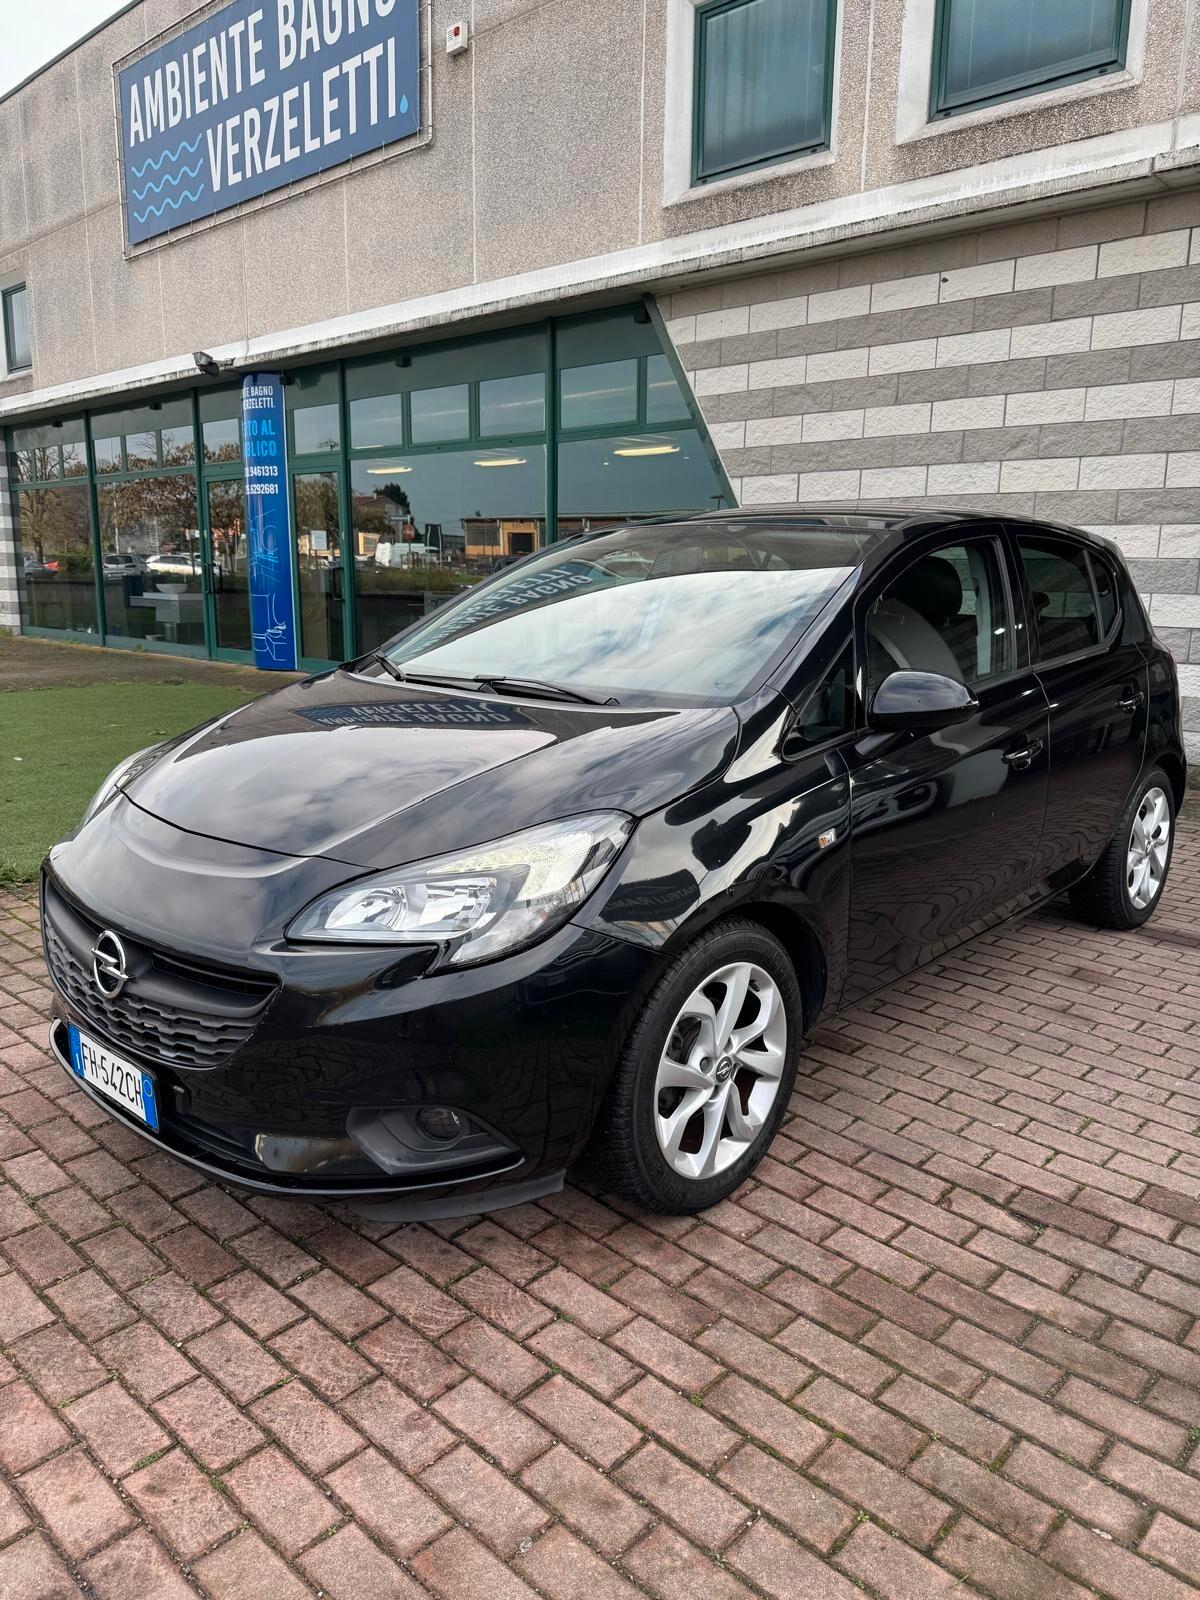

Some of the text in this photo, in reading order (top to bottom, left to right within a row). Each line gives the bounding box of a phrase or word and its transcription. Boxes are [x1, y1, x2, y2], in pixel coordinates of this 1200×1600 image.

[129, 0, 396, 148] AMBIENTE BAG
[206, 36, 397, 193] VERZELETTI
[250, 385, 273, 397] BAGNO
[261, 419, 276, 435] AL
